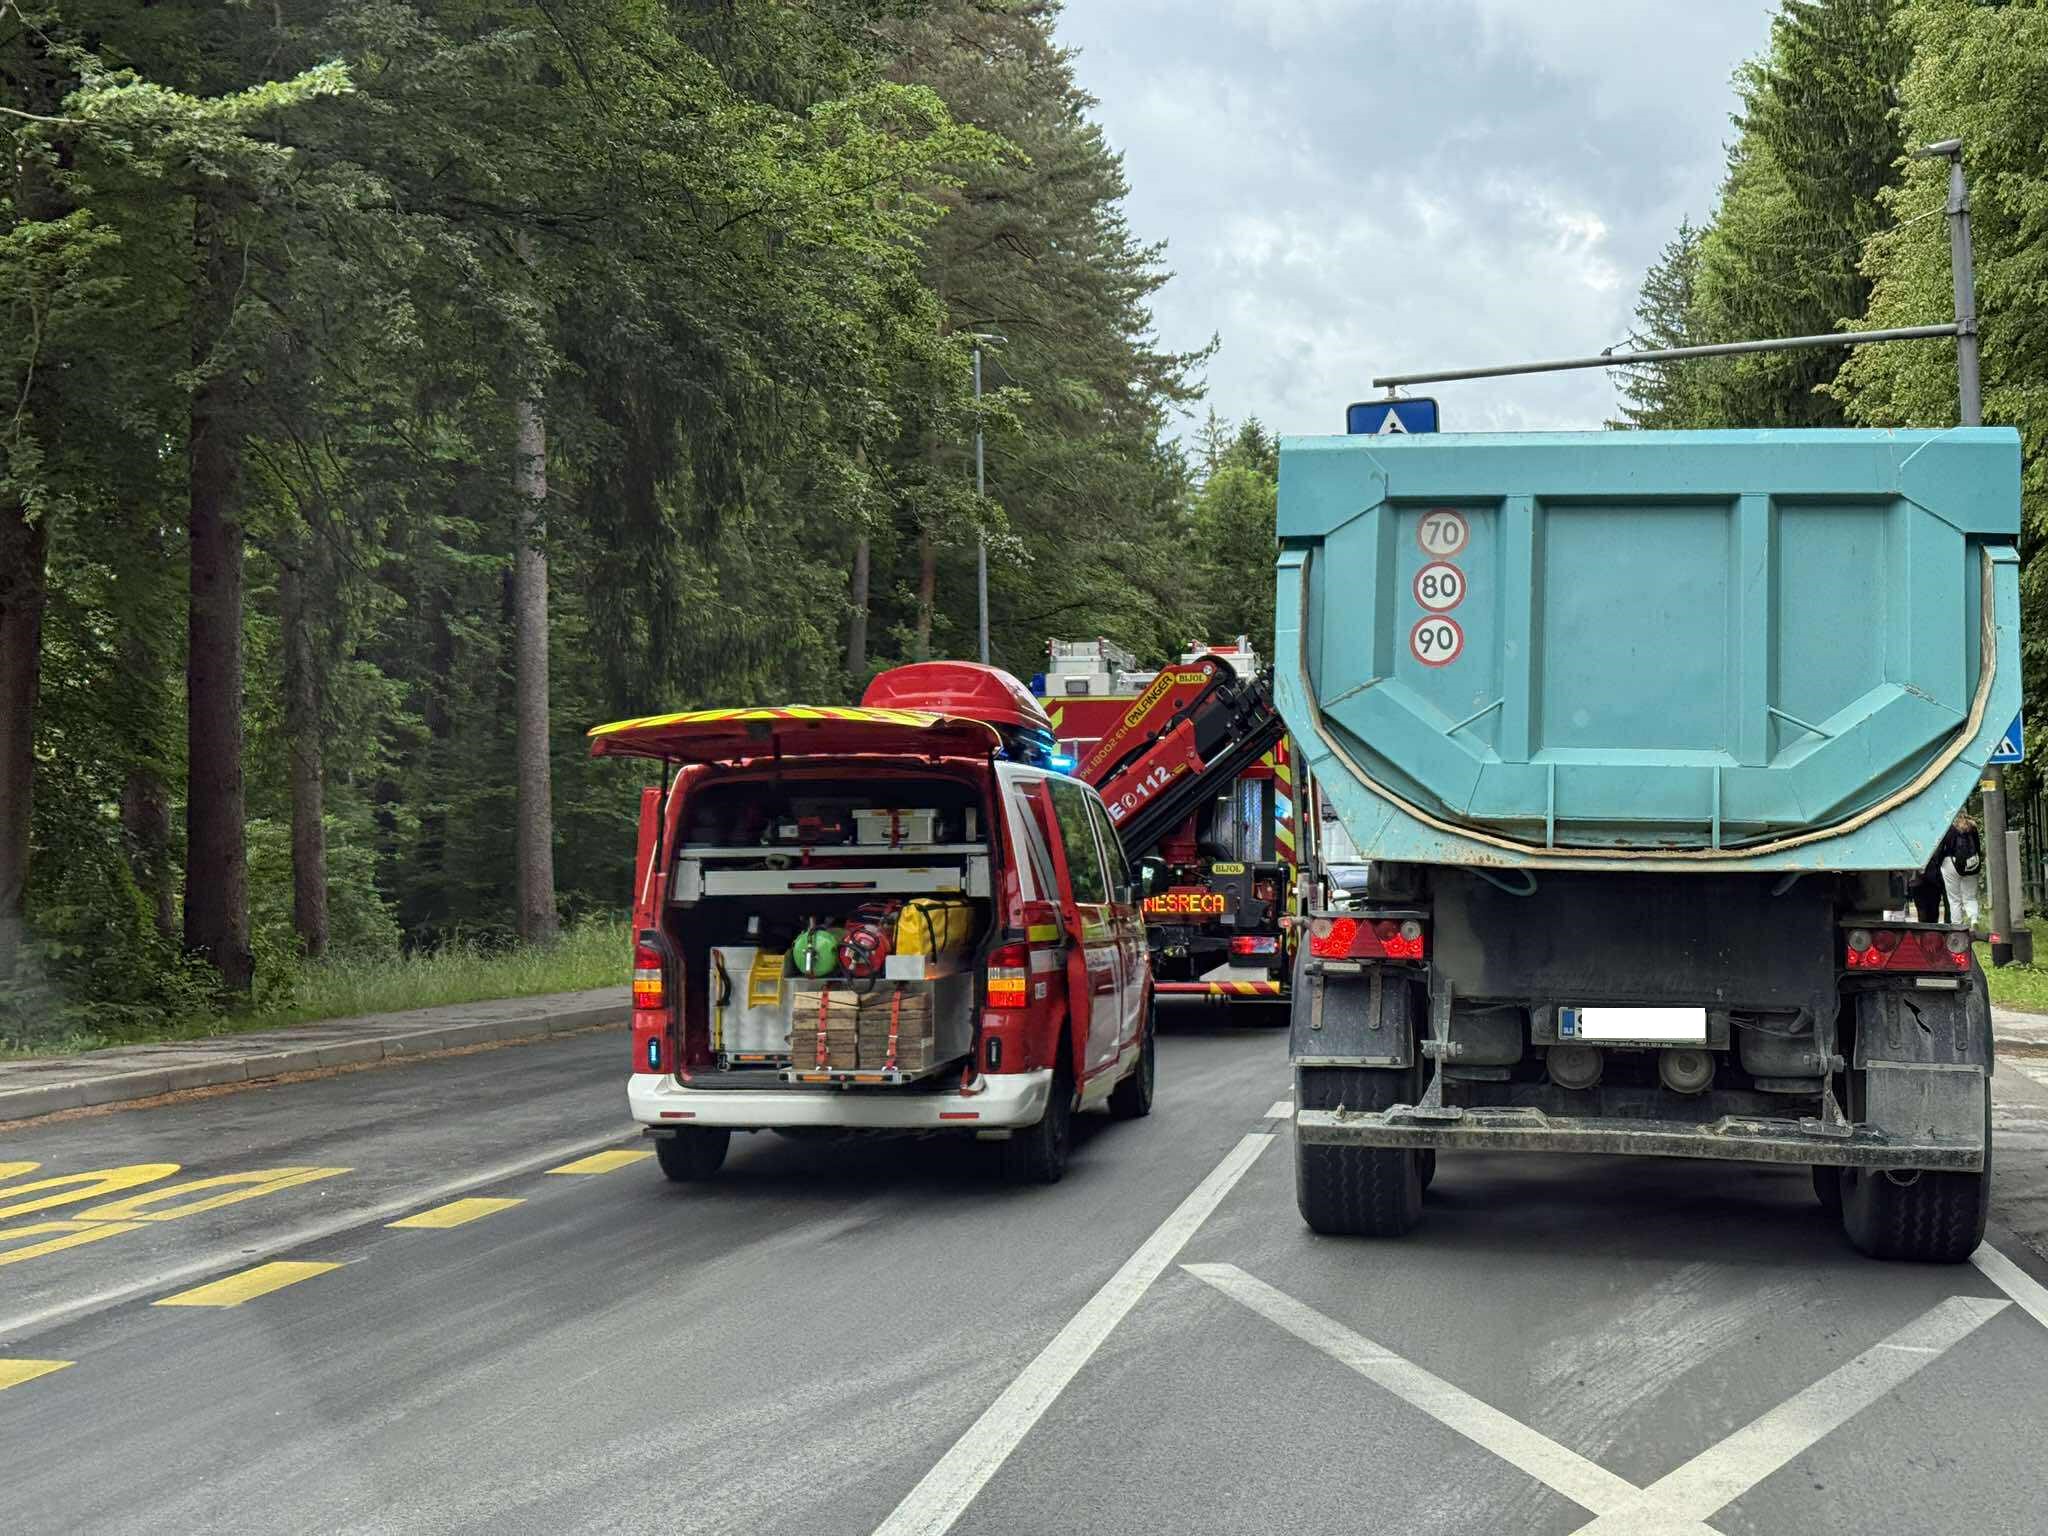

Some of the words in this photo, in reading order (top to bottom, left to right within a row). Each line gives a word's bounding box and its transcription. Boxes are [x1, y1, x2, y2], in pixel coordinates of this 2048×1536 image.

[1426, 520, 1460, 546] 70
[1421, 573, 1457, 599] 80
[1417, 625, 1454, 654] 90
[1178, 673, 1205, 682] BIJOL
[1126, 674, 1174, 725] PALFINGER
[1135, 766, 1171, 798] 112
